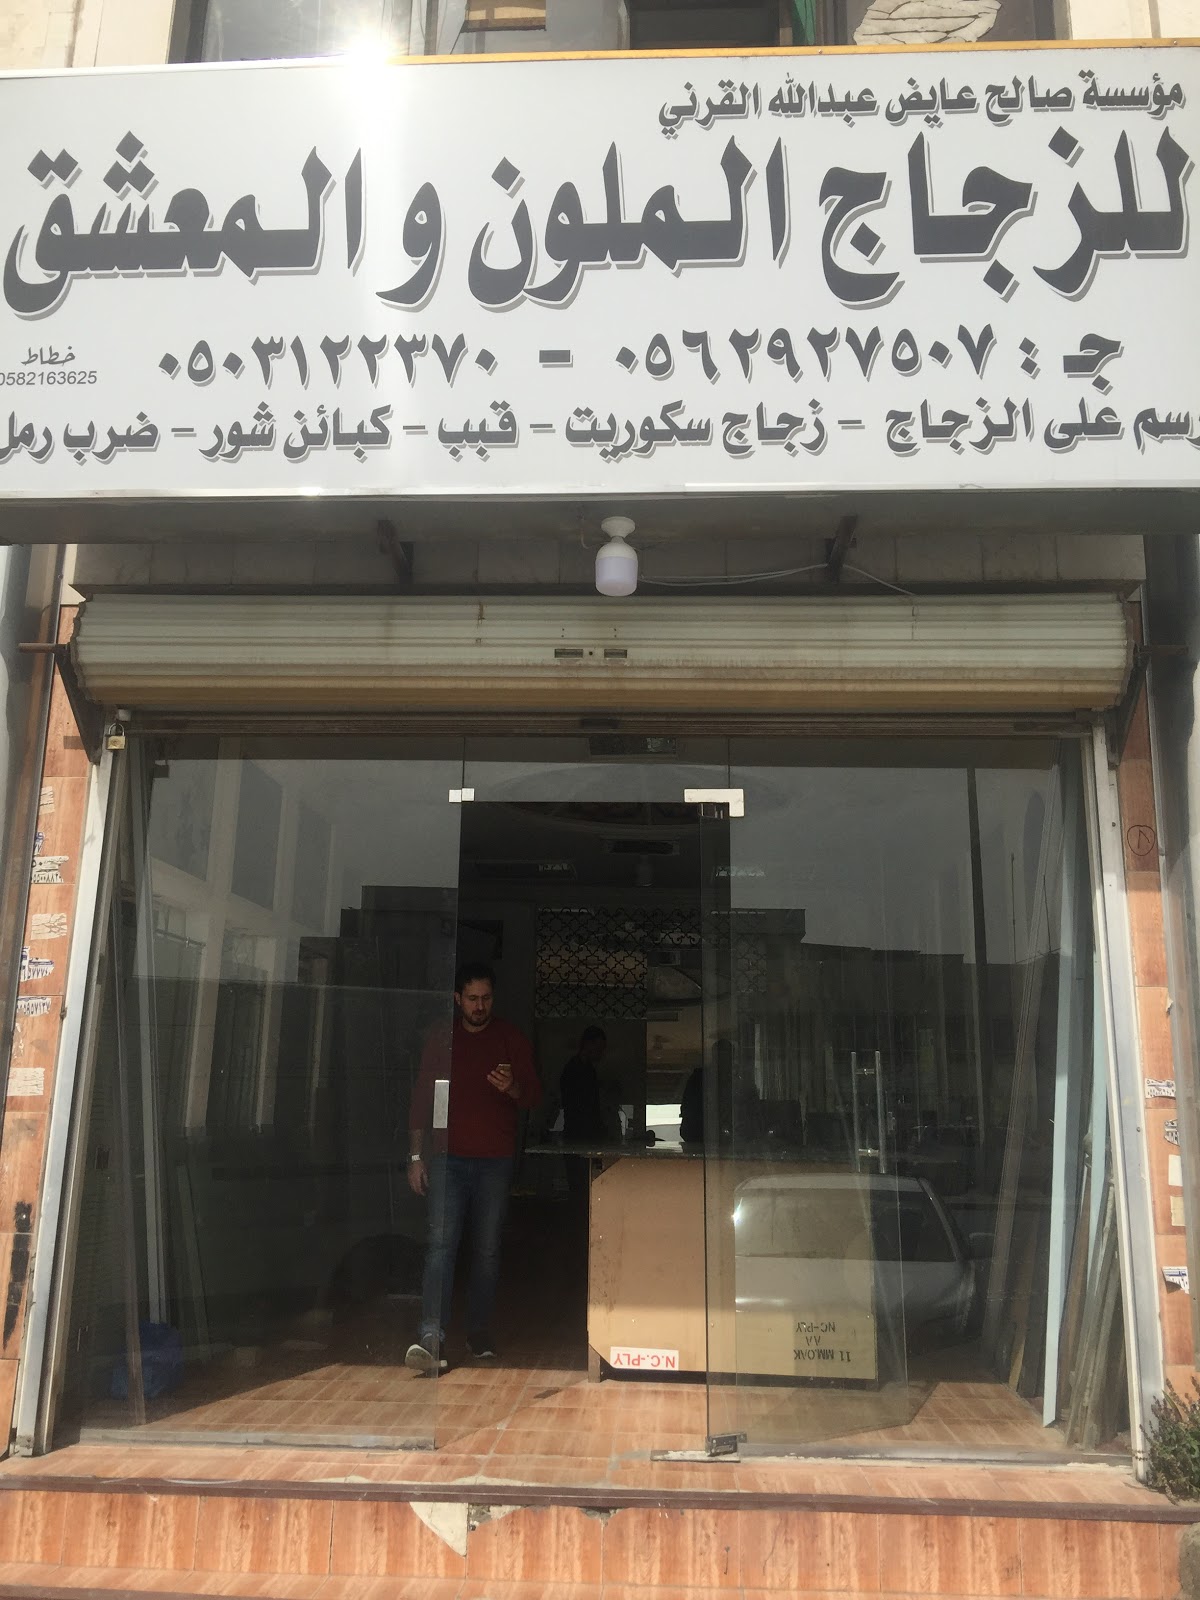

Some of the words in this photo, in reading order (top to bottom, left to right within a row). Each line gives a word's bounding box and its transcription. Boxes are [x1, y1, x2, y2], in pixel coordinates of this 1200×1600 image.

[658, 79, 761, 138] القرني
[886, 77, 979, 127] عايض
[985, 75, 1074, 126] صالح
[1079, 70, 1185, 119] مؤسسة
[468, 136, 790, 309] الملون
[819, 126, 1192, 310] للزجاج
[0, 370, 98, 386] 0582163625
[21, 345, 76, 366] خطاط
[158, 333, 498, 387] ٠٥٠٣١٢٢٣٧٠
[615, 324, 997, 382] ٠٥٦٢٩٢٧٥٠٧
[0, 411, 54, 464] رمل
[63, 411, 161, 466] ضرب
[198, 401, 274, 459] شور
[283, 404, 391, 463] كبائن
[438, 400, 520, 459] قبب
[565, 399, 713, 463] سكوريت
[721, 398, 828, 459] زجاج
[885, 396, 1031, 455] الزجاج
[1043, 397, 1124, 454] على
[613, 1352, 676, 1369] N.C.-PLY
